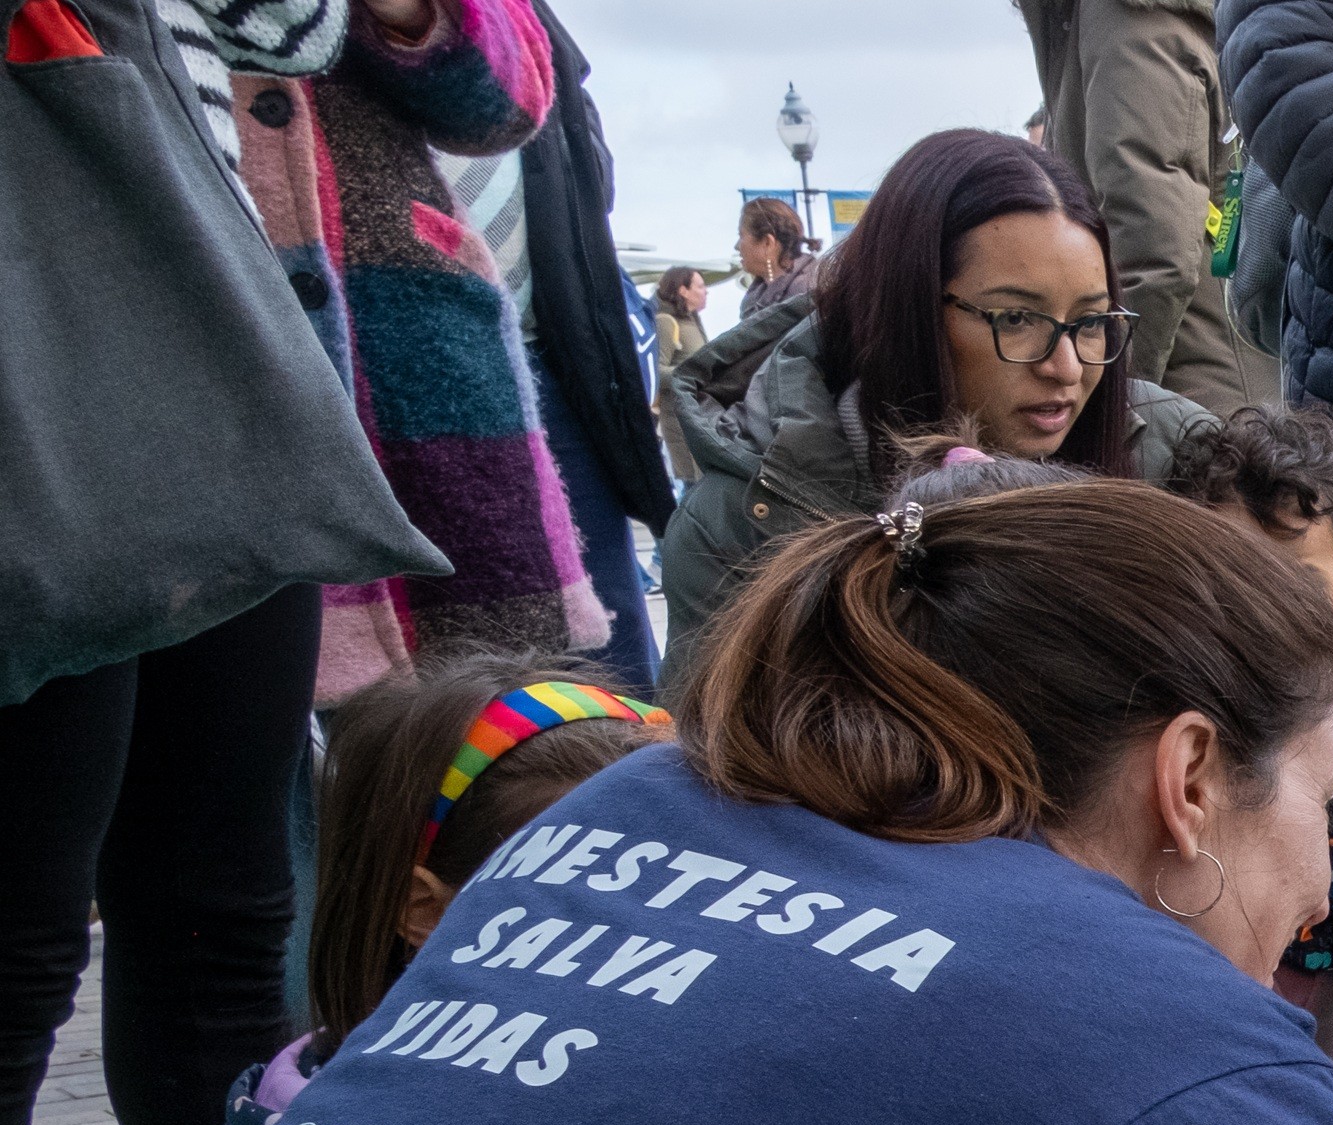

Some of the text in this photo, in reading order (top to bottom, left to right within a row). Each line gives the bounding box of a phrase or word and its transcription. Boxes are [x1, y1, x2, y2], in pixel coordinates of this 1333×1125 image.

[451, 906, 718, 1005] SALVA
[460, 823, 957, 993] ANESTESIA
[362, 1000, 599, 1087] VIDAS
